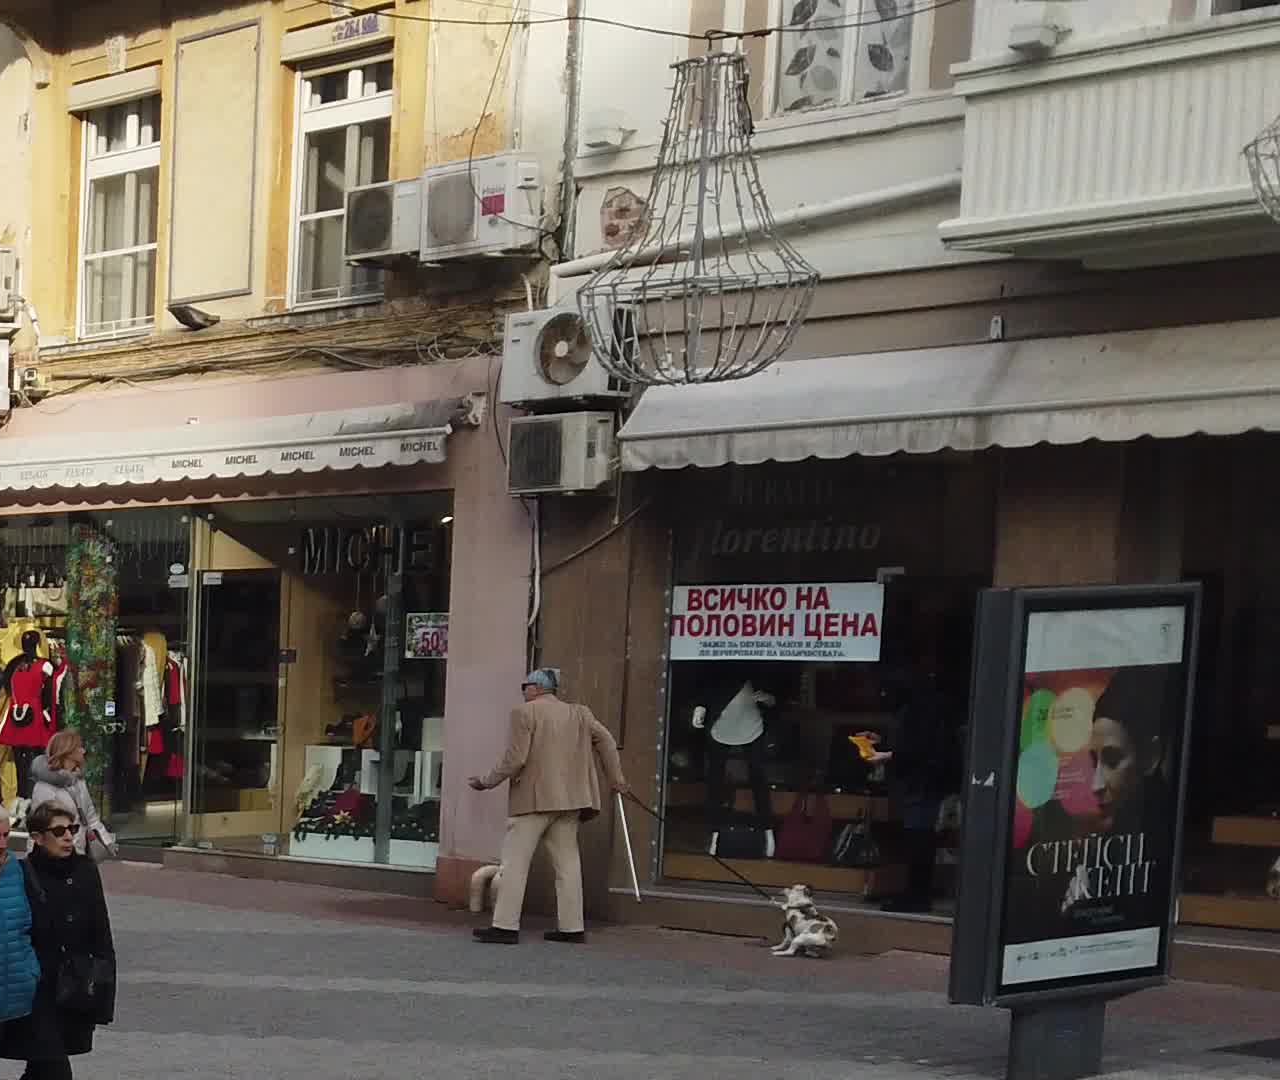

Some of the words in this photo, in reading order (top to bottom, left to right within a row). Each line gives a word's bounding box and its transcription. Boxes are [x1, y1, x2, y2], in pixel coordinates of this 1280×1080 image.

[339, 446, 375, 457] MICHEL
[400, 440, 438, 453] MICHEL
[225, 454, 258, 466] MICHEL
[280, 450, 315, 462] MICHEL
[171, 458, 203, 469] MICHEL
[687, 586, 787, 612] ВСИЧКО
[795, 586, 830, 610] НА
[671, 613, 795, 638] ПОЛОВИН
[803, 612, 879, 641] ЦЕНА
